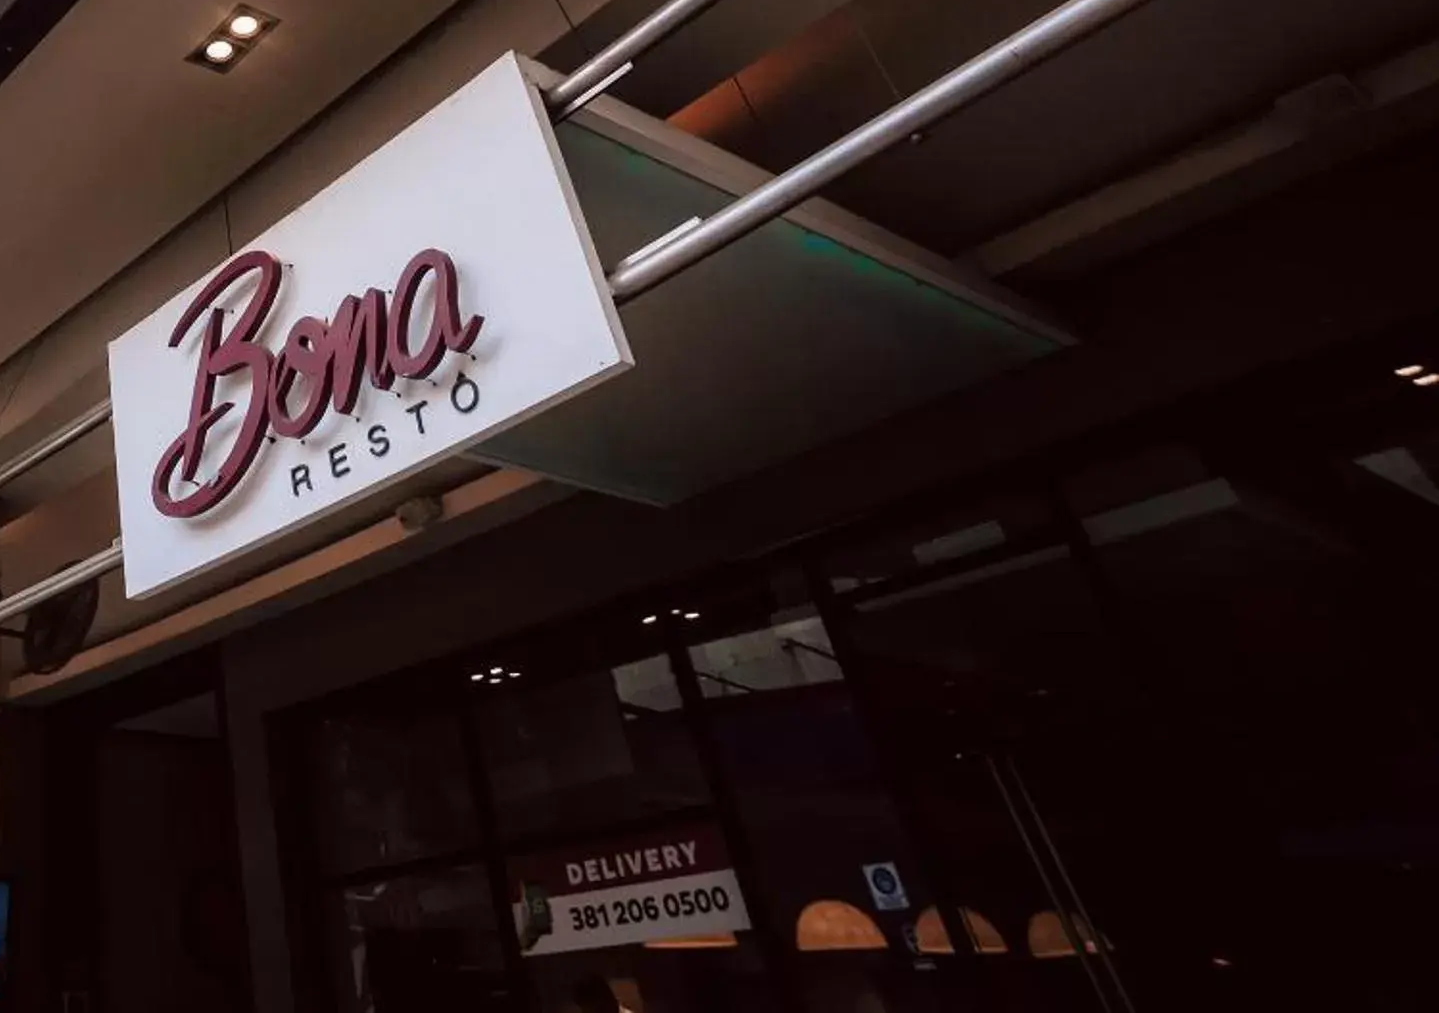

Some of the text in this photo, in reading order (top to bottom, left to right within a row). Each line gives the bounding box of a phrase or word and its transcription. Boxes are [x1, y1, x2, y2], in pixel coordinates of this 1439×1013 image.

[151, 248, 485, 518] Bona
[566, 841, 698, 886] DELIVERY
[569, 886, 730, 931] 381 206 0500
